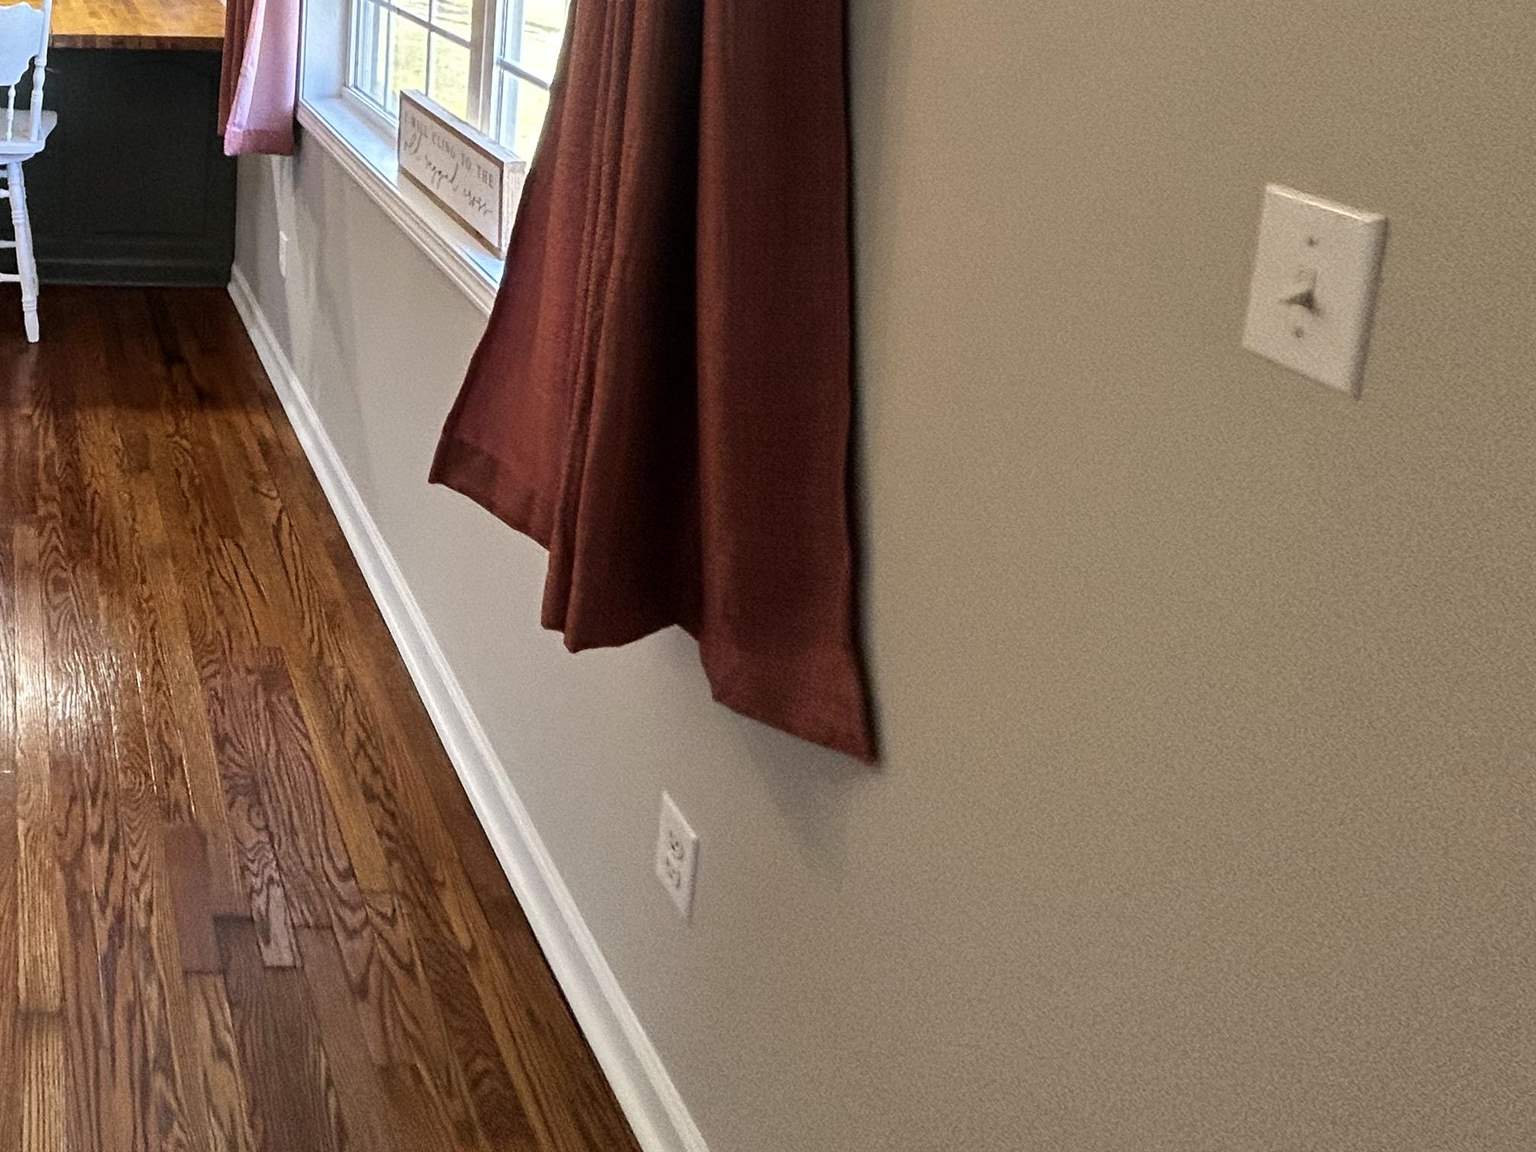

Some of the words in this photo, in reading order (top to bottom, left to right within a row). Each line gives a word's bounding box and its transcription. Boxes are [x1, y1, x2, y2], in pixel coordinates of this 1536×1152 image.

[431, 130, 456, 159] CLING
[461, 152, 472, 171] TO
[477, 164, 494, 189] THE
